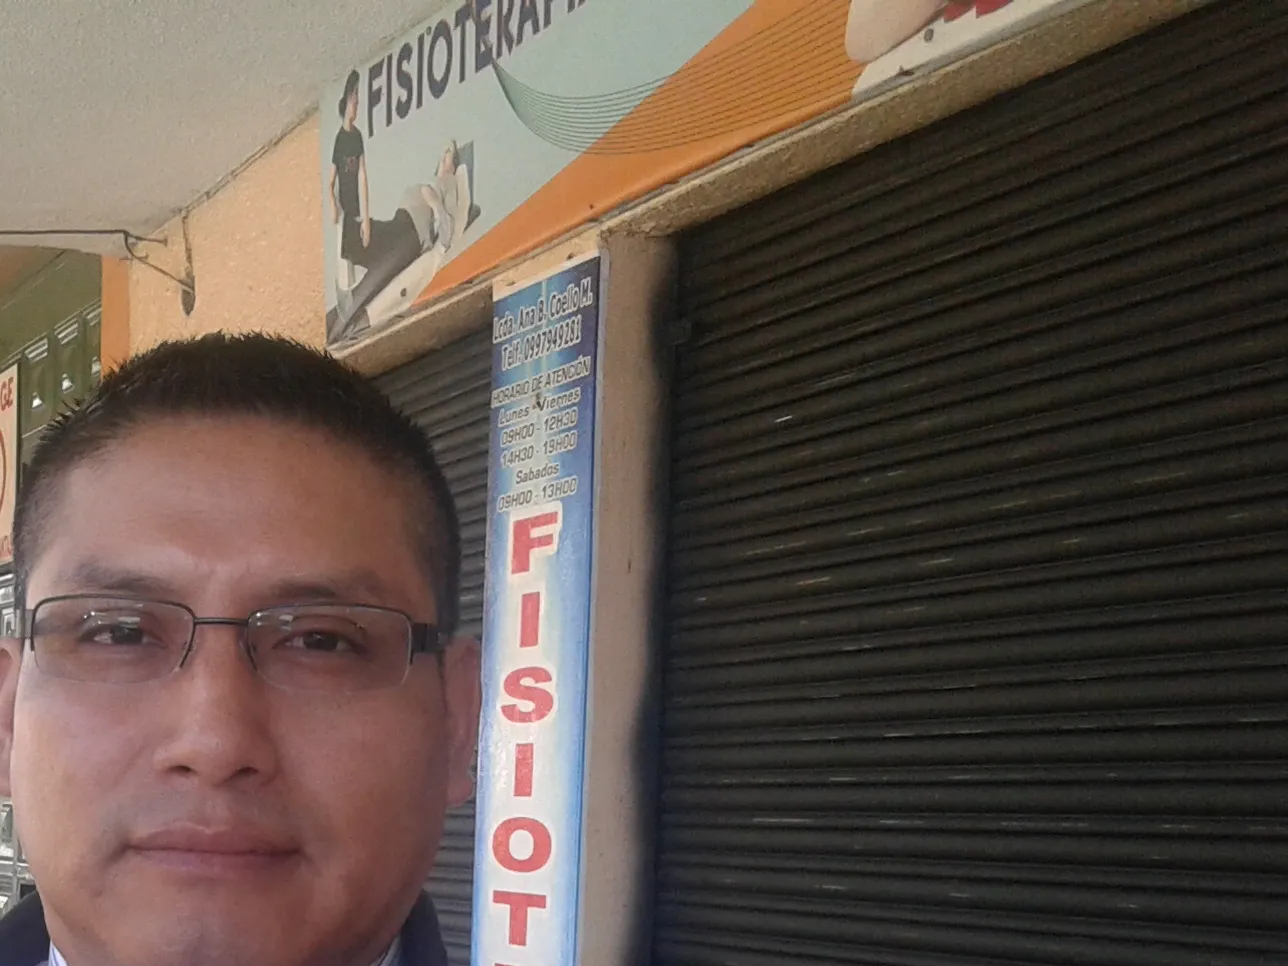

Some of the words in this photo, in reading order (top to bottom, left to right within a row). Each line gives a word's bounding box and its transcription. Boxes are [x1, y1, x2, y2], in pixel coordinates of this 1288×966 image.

[367, 0, 586, 138] FISIOTERA
[518, 306, 536, 329] Ana
[549, 283, 579, 319] Coello
[492, 380, 530, 406] HORARIO
[531, 374, 544, 393] DE
[499, 406, 530, 427] Lunes
[537, 388, 580, 412] Viernes
